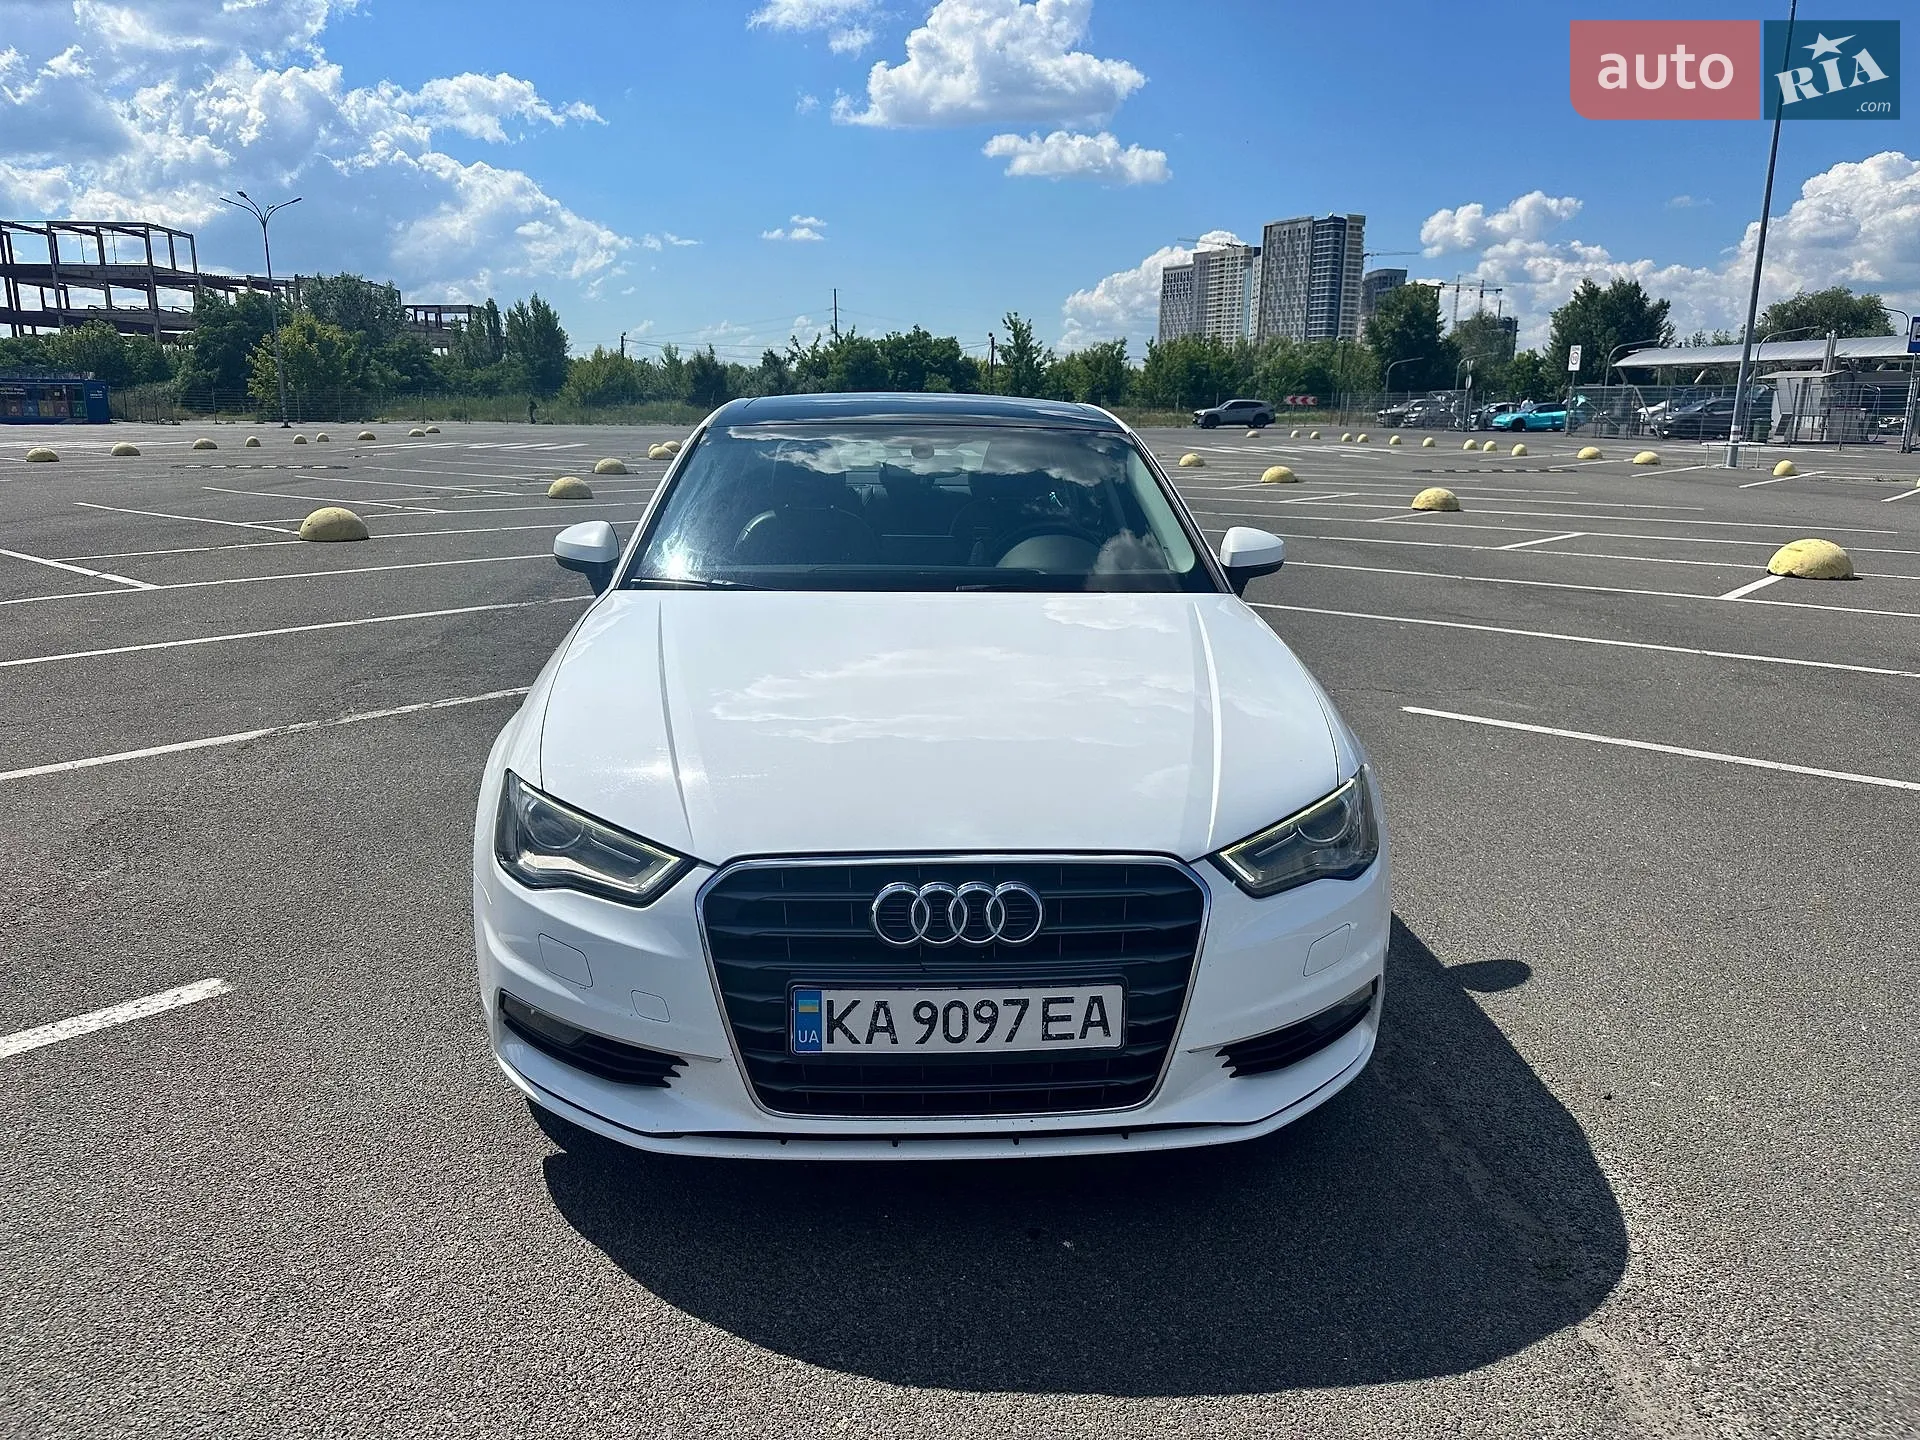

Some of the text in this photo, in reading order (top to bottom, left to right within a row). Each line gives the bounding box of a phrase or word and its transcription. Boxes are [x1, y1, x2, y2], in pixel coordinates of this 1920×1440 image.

[798, 1029, 819, 1043] UA
[826, 995, 1112, 1045] KA 9097 EA
